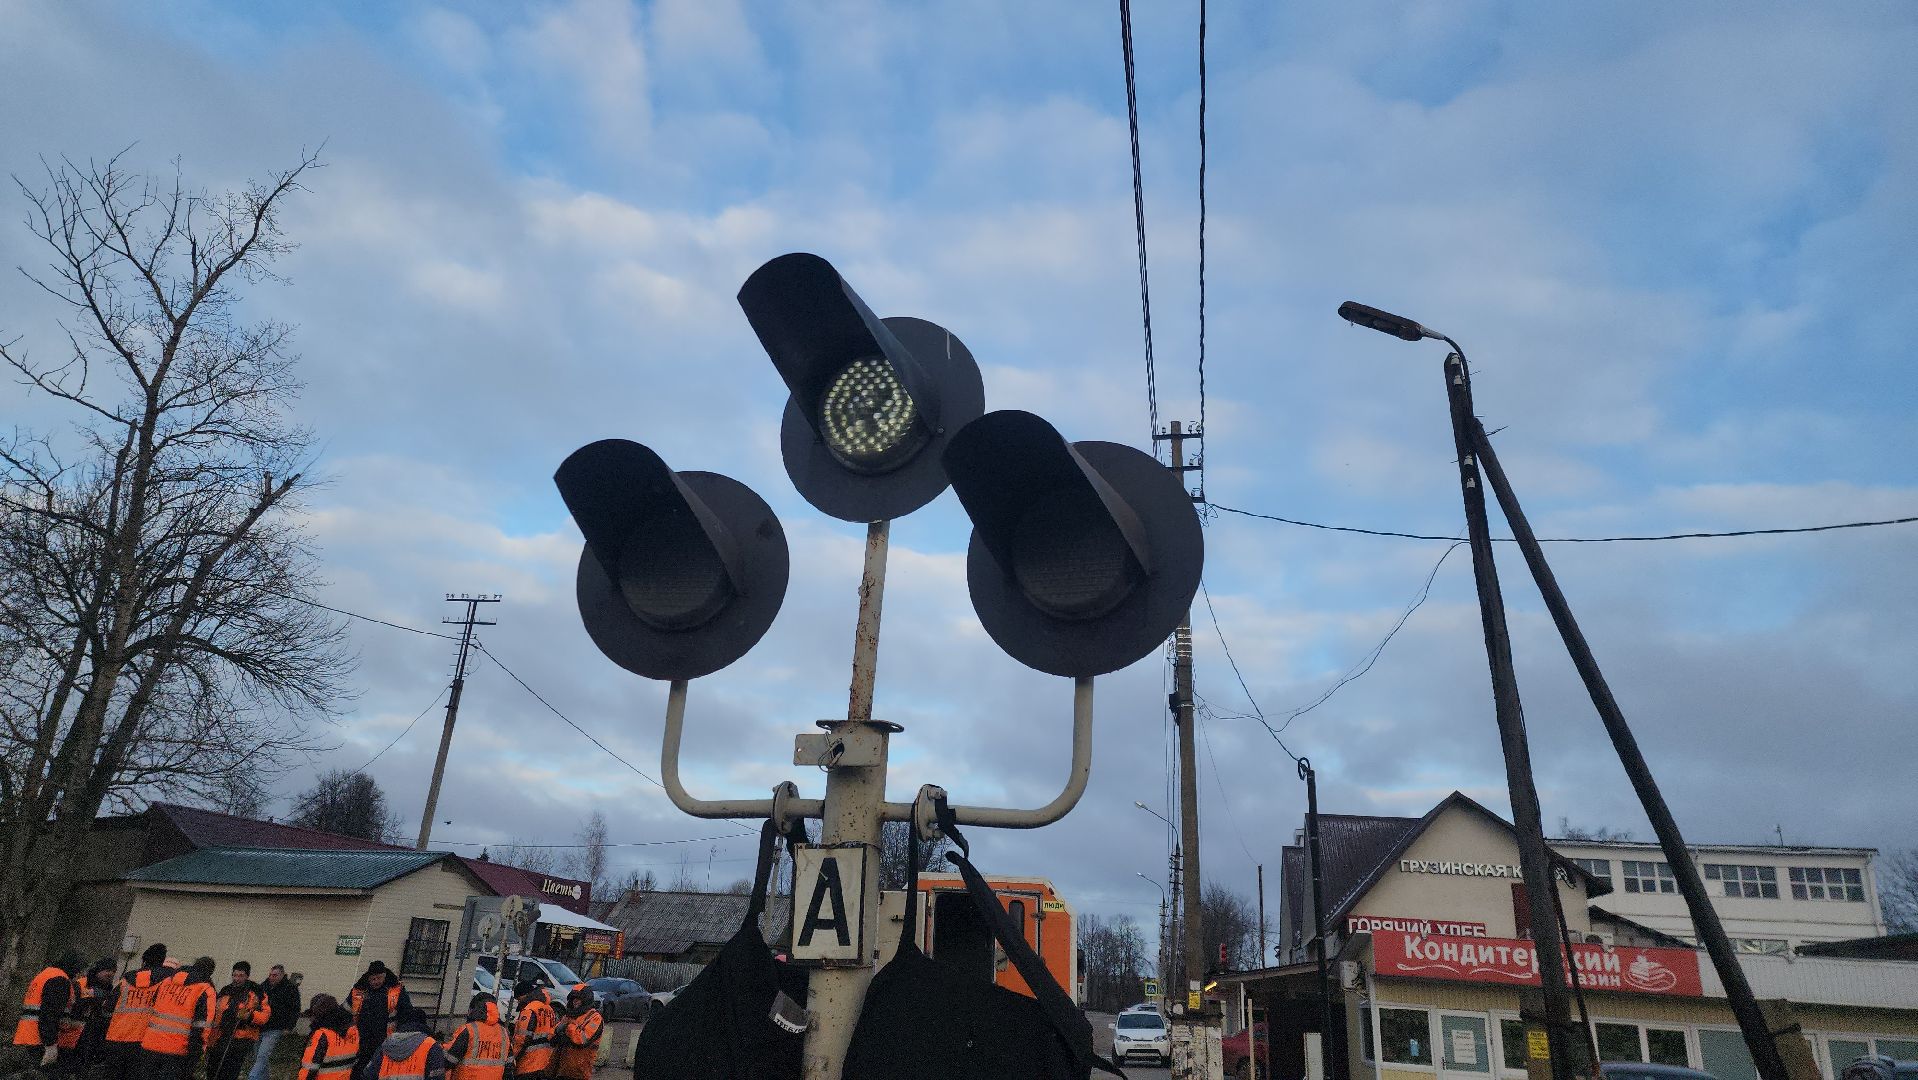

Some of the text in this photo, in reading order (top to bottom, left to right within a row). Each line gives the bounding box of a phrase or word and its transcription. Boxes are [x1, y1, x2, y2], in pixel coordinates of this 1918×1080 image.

[1400, 859, 1508, 878] ГРУЗИНСКАЯ
[798, 858, 851, 946] А
[1404, 935, 1620, 973] Кондитекий
